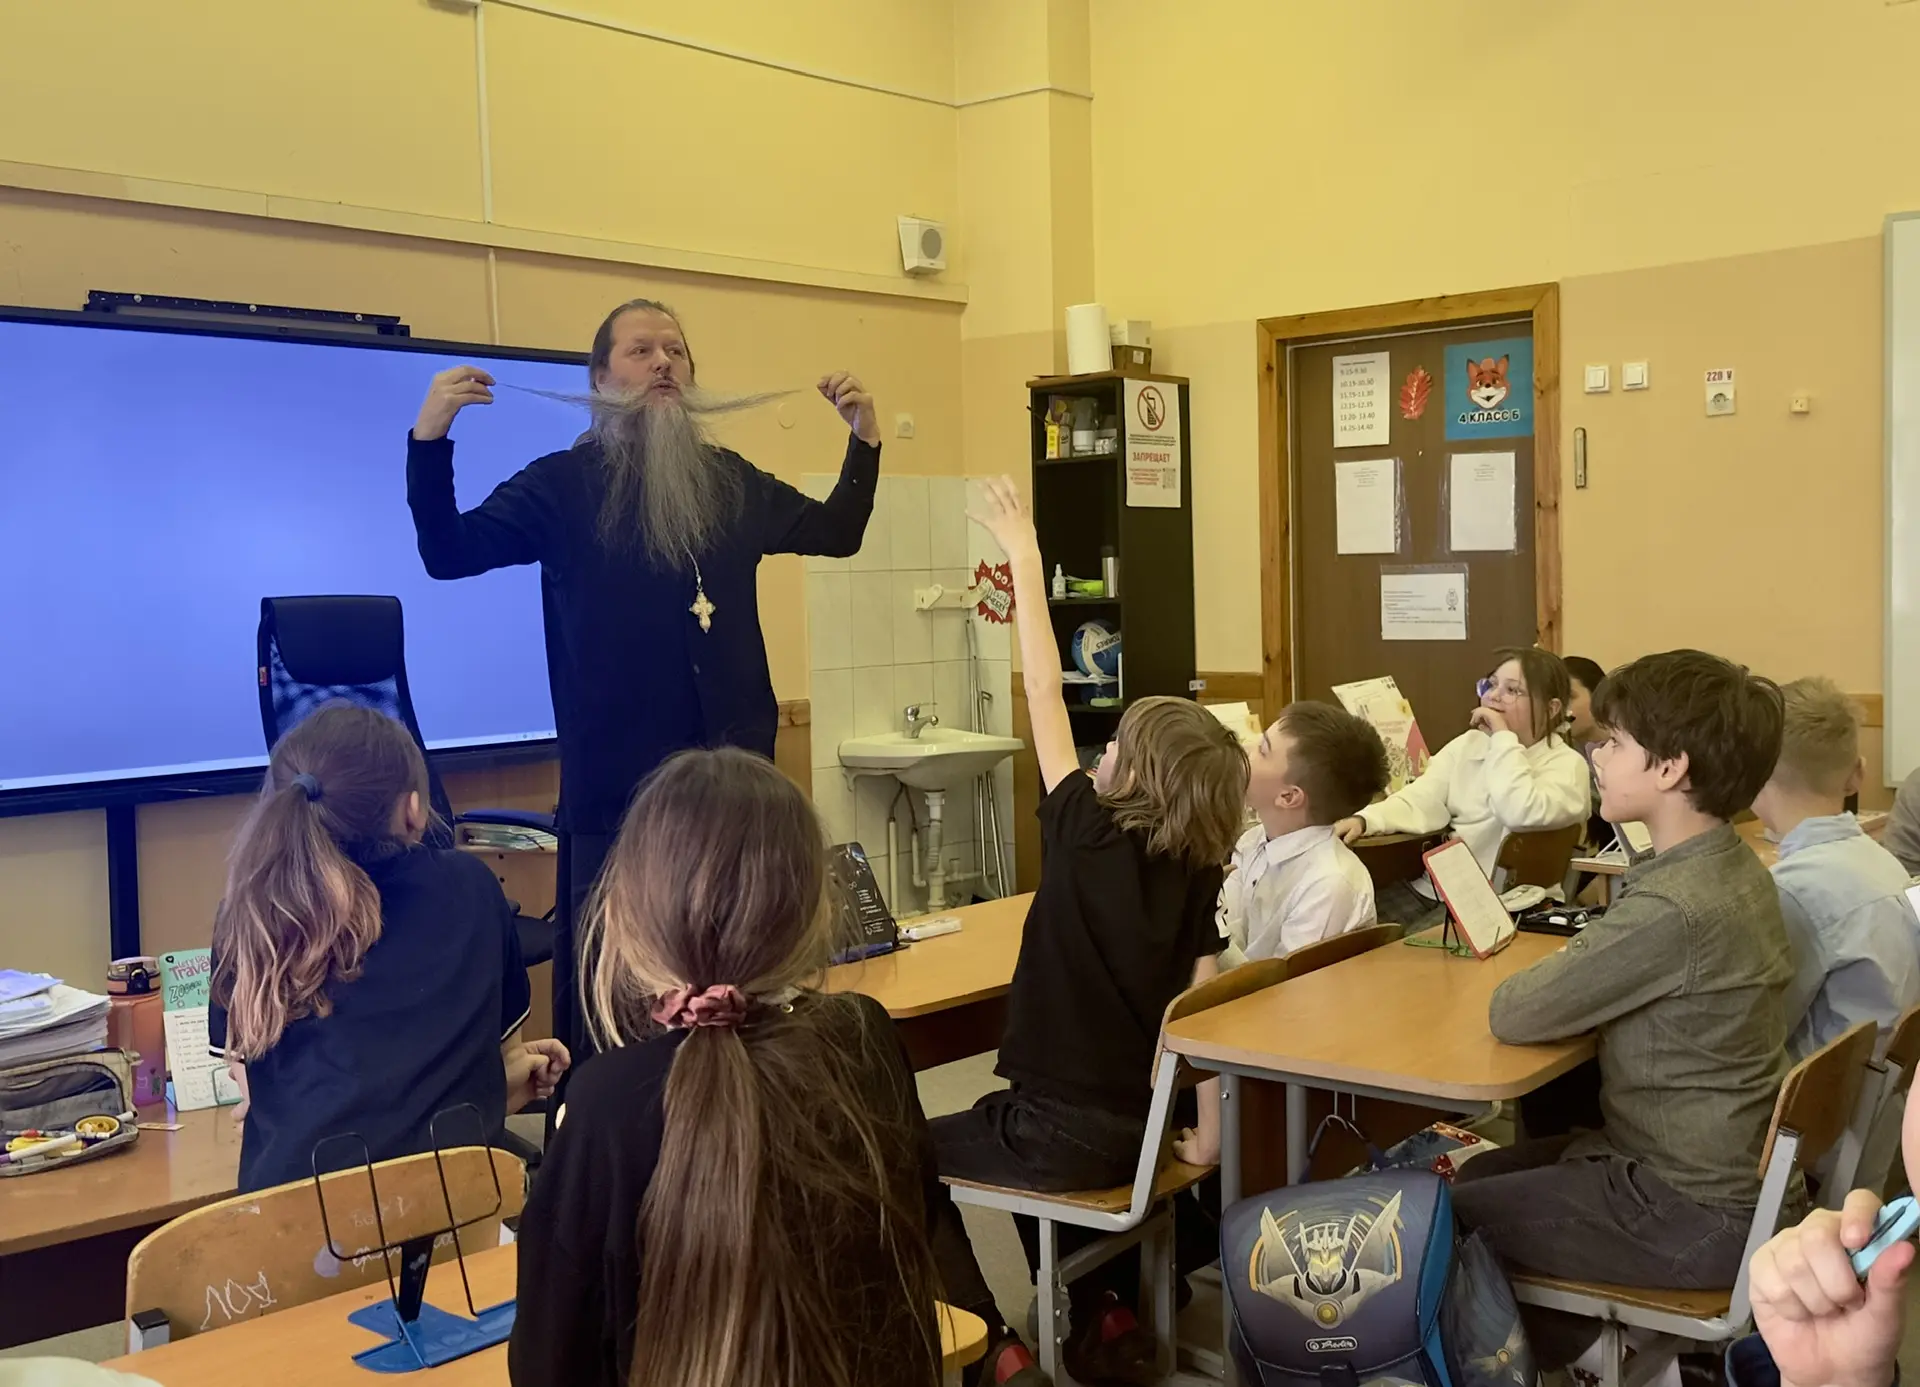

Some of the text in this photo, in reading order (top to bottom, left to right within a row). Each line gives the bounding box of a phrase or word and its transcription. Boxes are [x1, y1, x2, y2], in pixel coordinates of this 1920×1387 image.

[1707, 370, 1732, 382] 220 V
[1459, 413, 1467, 423] 4
[1469, 410, 1509, 422] КЛАСС
[1133, 452, 1170, 463] ЗАПРЕЩАЕТ
